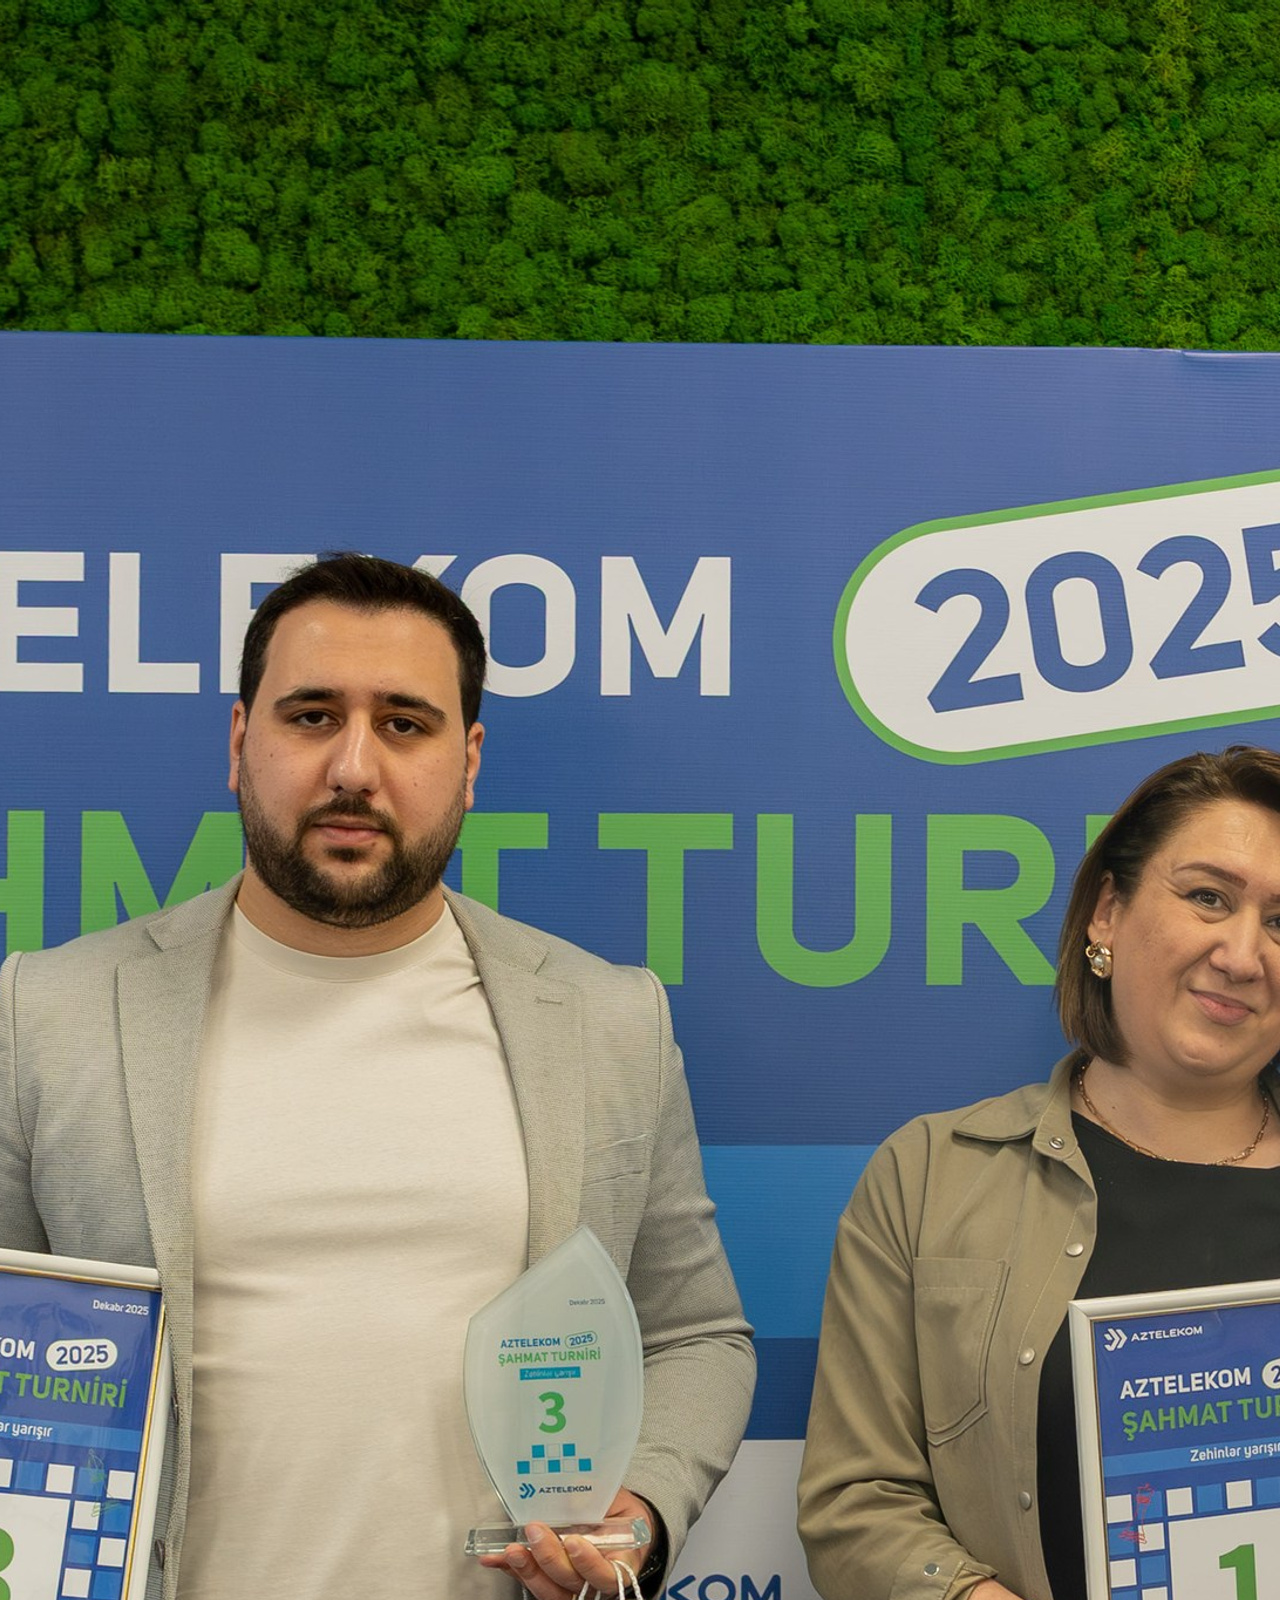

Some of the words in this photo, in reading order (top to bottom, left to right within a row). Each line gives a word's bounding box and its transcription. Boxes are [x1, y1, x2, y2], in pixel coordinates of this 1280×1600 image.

[93, 1299, 125, 1313] Dekabr
[125, 1303, 150, 1316] 2025
[500, 1337, 561, 1348] AZTELEKOM
[569, 1334, 593, 1346] 2025
[1131, 1326, 1203, 1342] AZTELEKOM
[0, 1337, 36, 1360] OM
[56, 1345, 109, 1365] 2025
[498, 1352, 549, 1367] ŞAHMAT
[551, 1346, 601, 1361] TURNİRİ
[15, 1370, 128, 1408] TURNİRİ
[1120, 1366, 1251, 1399] AZTELEKOM
[538, 1391, 567, 1433] 3
[1122, 1401, 1232, 1441] ŞAHMAT
[12, 1423, 53, 1440] yarışır
[539, 1485, 592, 1493] AZTELEKOM
